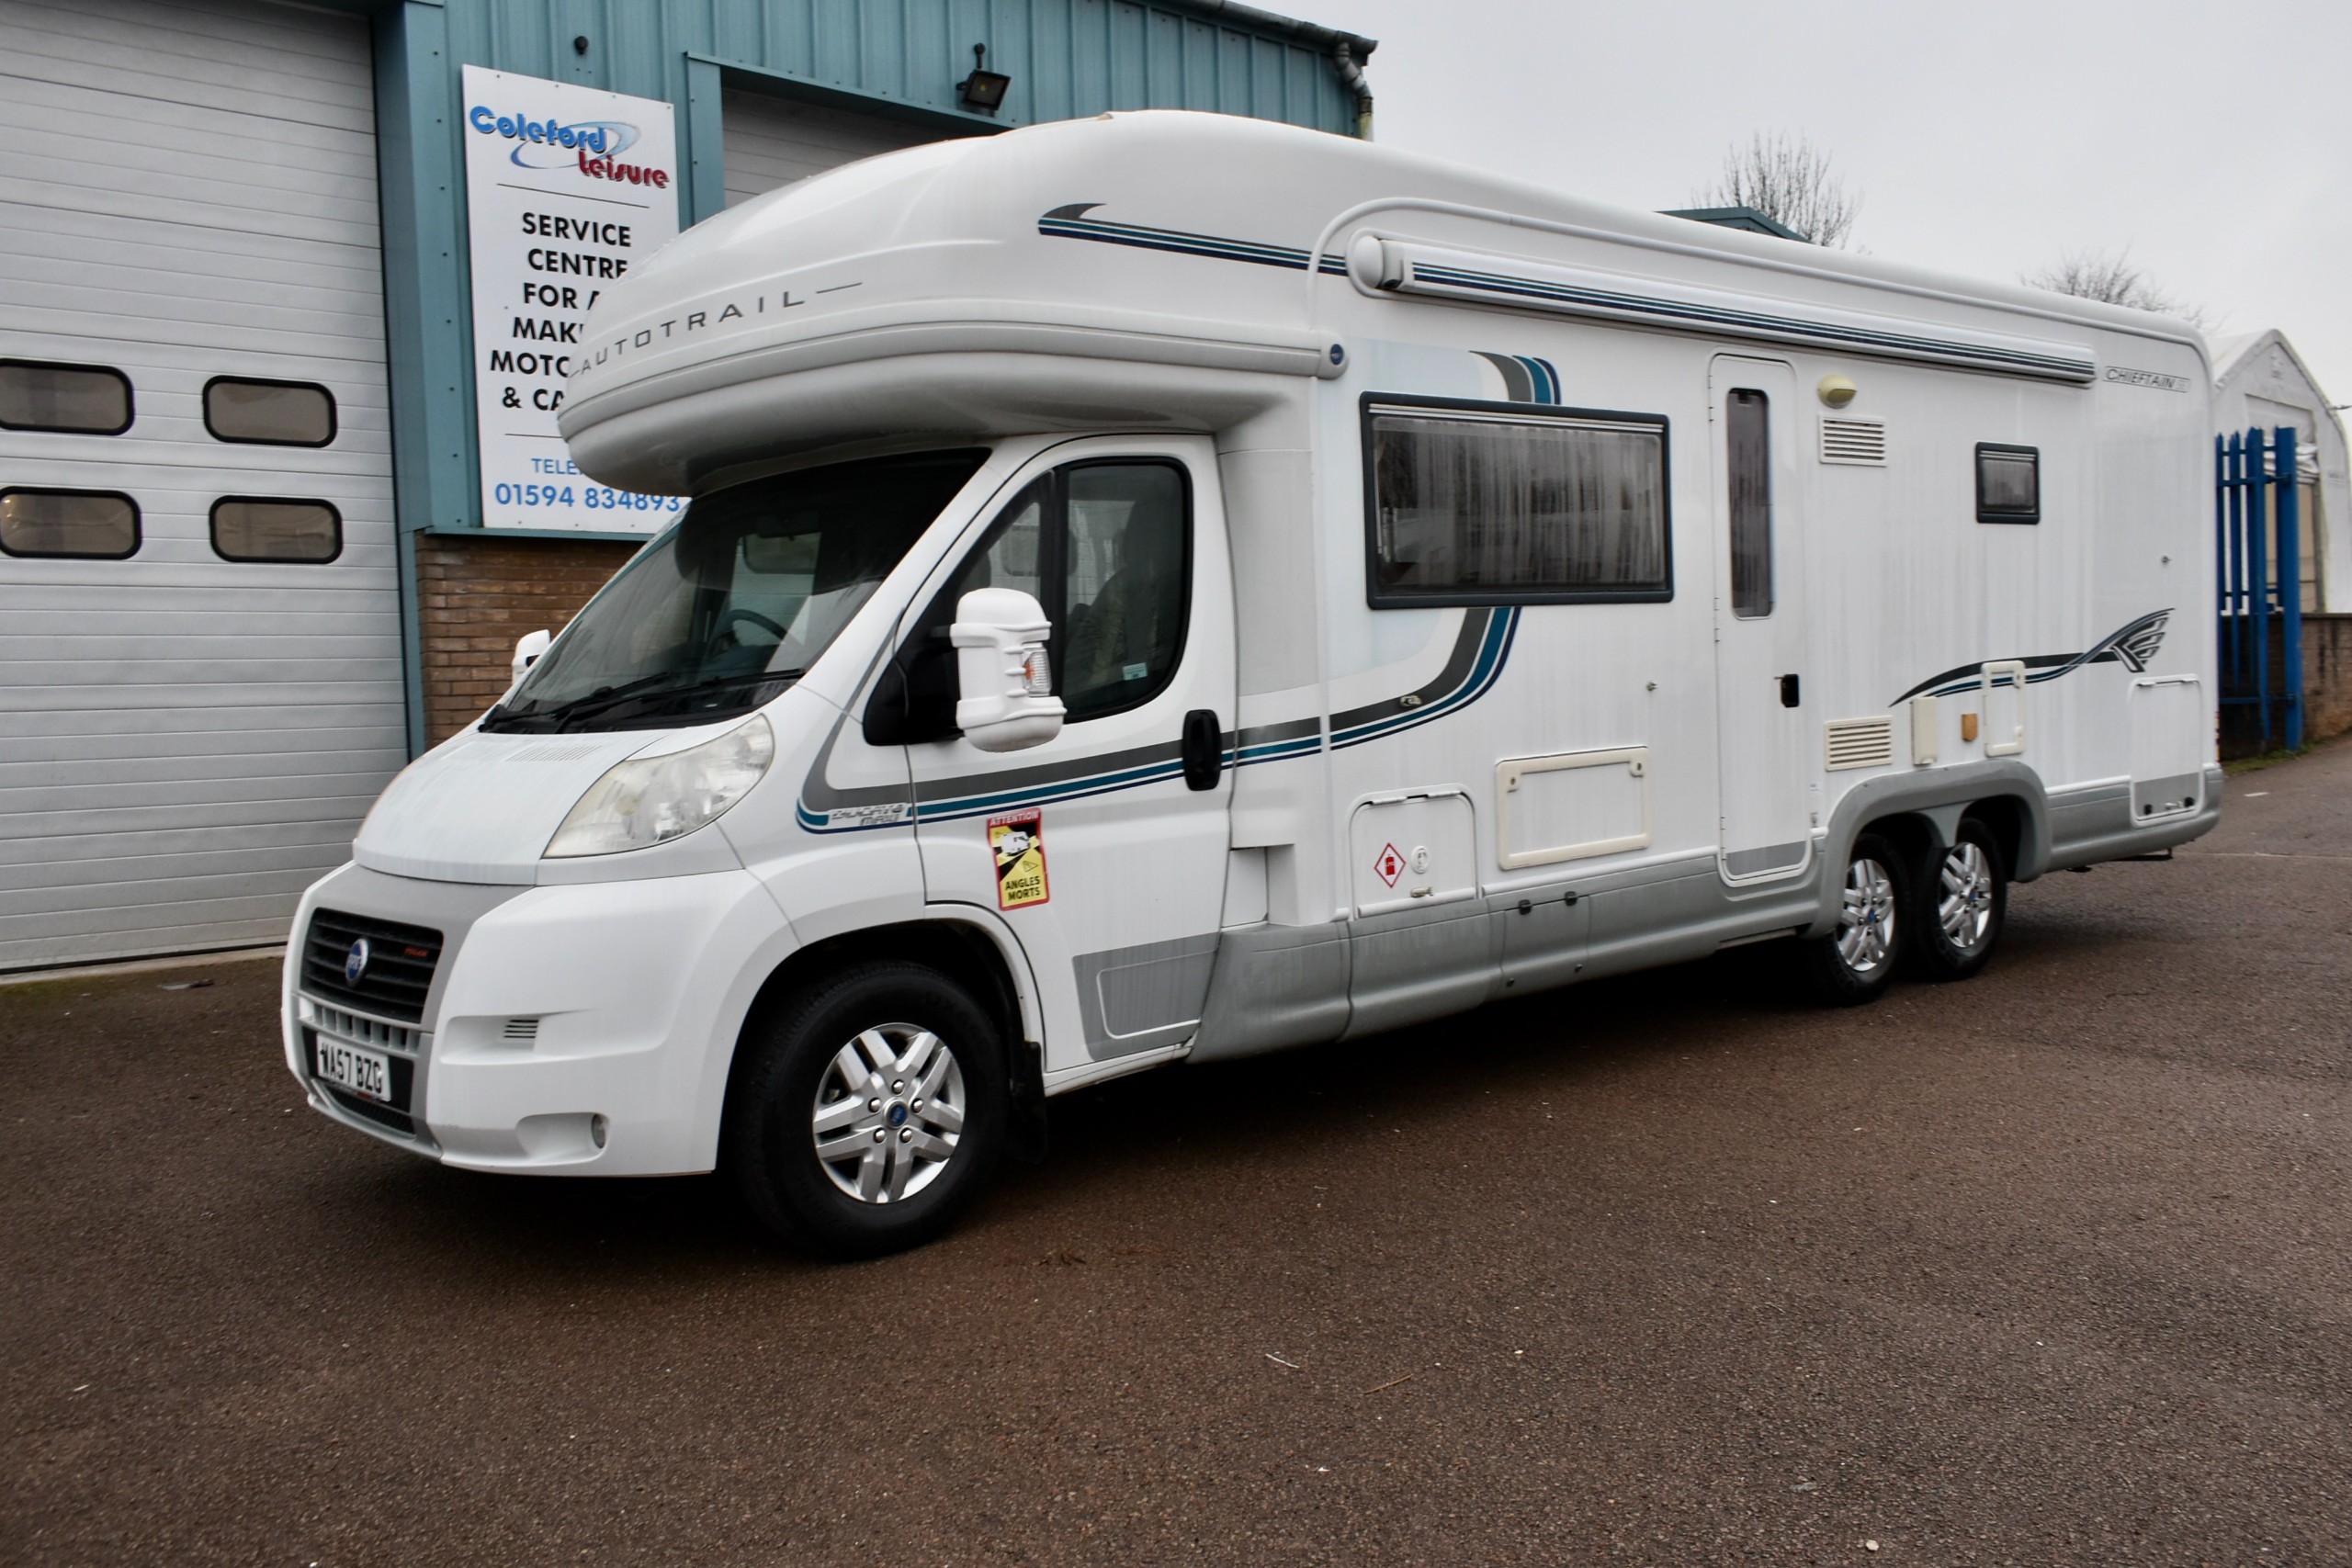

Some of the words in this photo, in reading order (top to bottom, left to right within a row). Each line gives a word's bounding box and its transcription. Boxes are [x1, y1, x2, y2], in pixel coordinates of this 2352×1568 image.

[469, 106, 607, 153] Coleford
[522, 212, 631, 247] SERVICE
[523, 282, 579, 310] FOR
[513, 317, 584, 344] MAK
[581, 291, 806, 376] AUTOTRAIL
[490, 350, 570, 378] MOTO
[2105, 368, 2177, 389] CHIEFTAIN
[503, 387, 523, 409] &
[530, 458, 582, 476] TELE
[495, 483, 574, 508] 01594
[585, 487, 681, 513] 834893
[1005, 875, 1041, 891] ANGLES
[1007, 886, 1041, 901] MORTS
[356, 1055, 382, 1094] BZG
